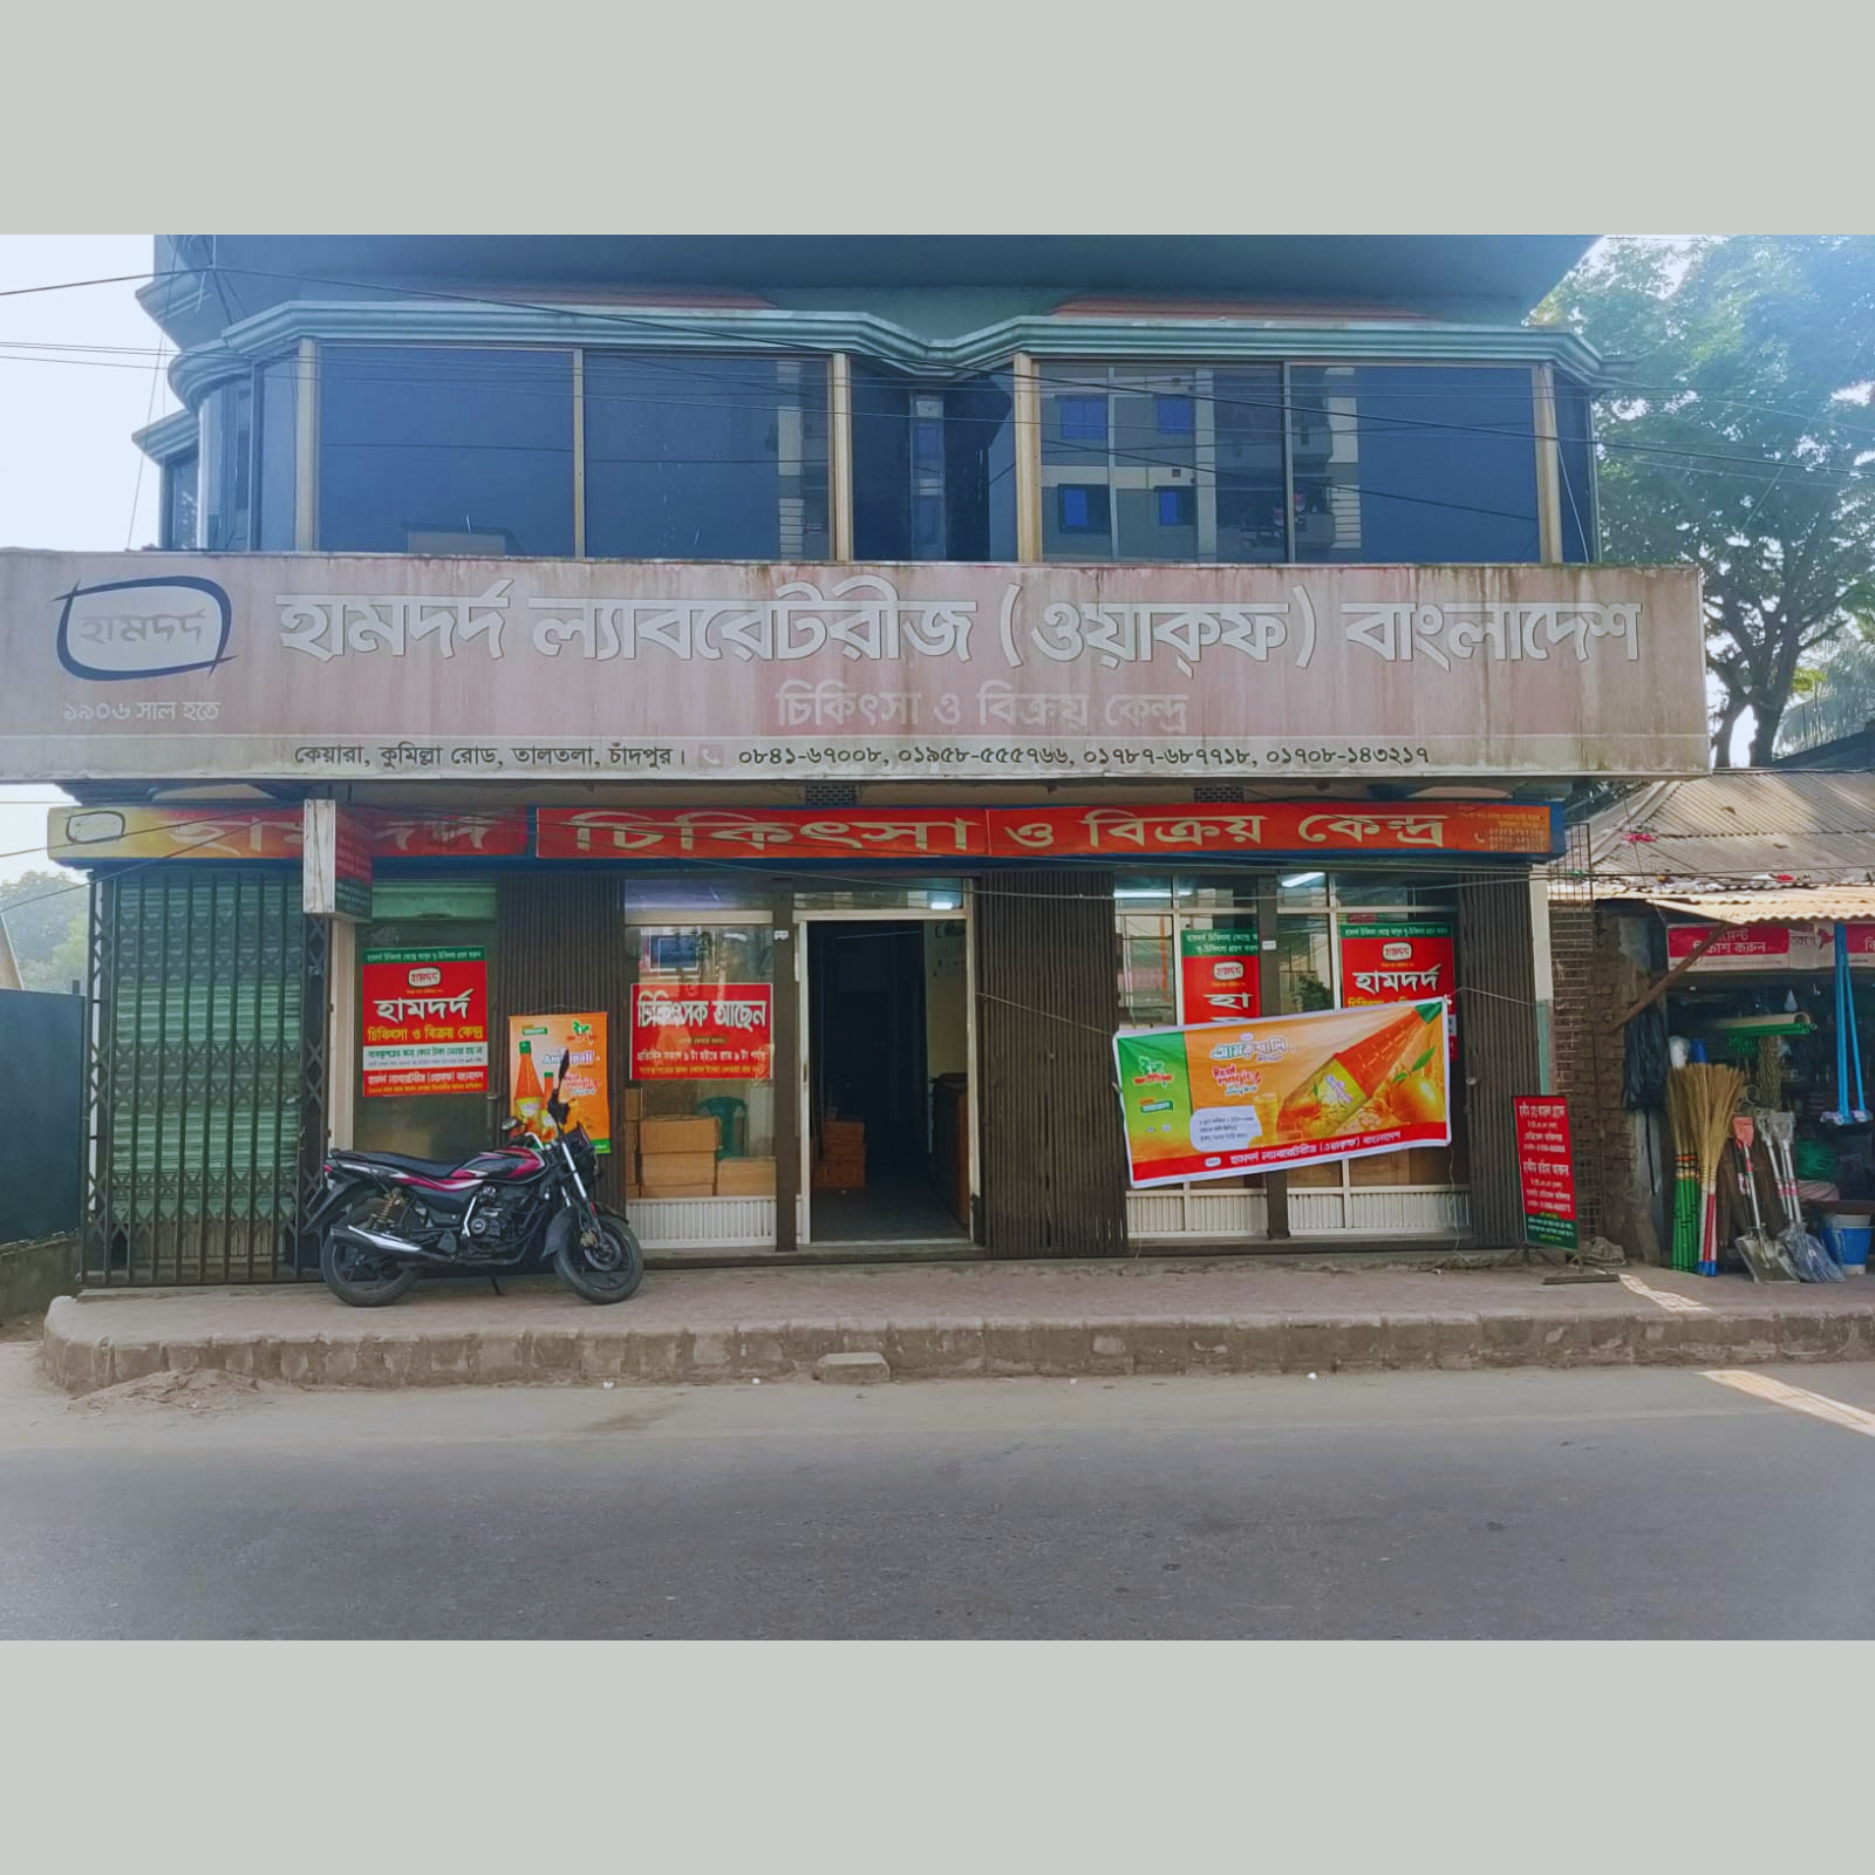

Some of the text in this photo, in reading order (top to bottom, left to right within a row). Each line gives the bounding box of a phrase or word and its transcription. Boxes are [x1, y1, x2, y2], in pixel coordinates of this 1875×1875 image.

[79, 607, 207, 645] হামদর্দ
[277, 578, 512, 662] হামদর্দ
[1340, 600, 1642, 671] বাংলাদেশ
[63, 701, 221, 722] ১৯০৬ সাল হতে
[776, 679, 1189, 734] চিকিৎসা ও বিক্রয় কেন্দ্র
[295, 744, 371, 768] কেয়ারা,
[377, 741, 444, 770] কুমিল্লা
[451, 744, 503, 769] রোড,
[511, 745, 600, 769] তালতলা,
[738, 746, 1430, 768] ০৮৪১-৬৭০০৮, ০১৯৫৮-৫৫৫৭৬৬, ০১৭৮৭-৬৮৭৭১৮, ০১৭০৮-১৪৩২১৭
[563, 810, 979, 852] চিকিৎসা
[1004, 822, 1054, 848] ও
[1084, 809, 1267, 845] বিক্রয়
[1298, 812, 1451, 848] কেন্দ্র
[1352, 963, 1442, 995] হামদর্দ
[374, 988, 474, 1023] হামদর্দ
[711, 1000, 767, 1032] আছেন
